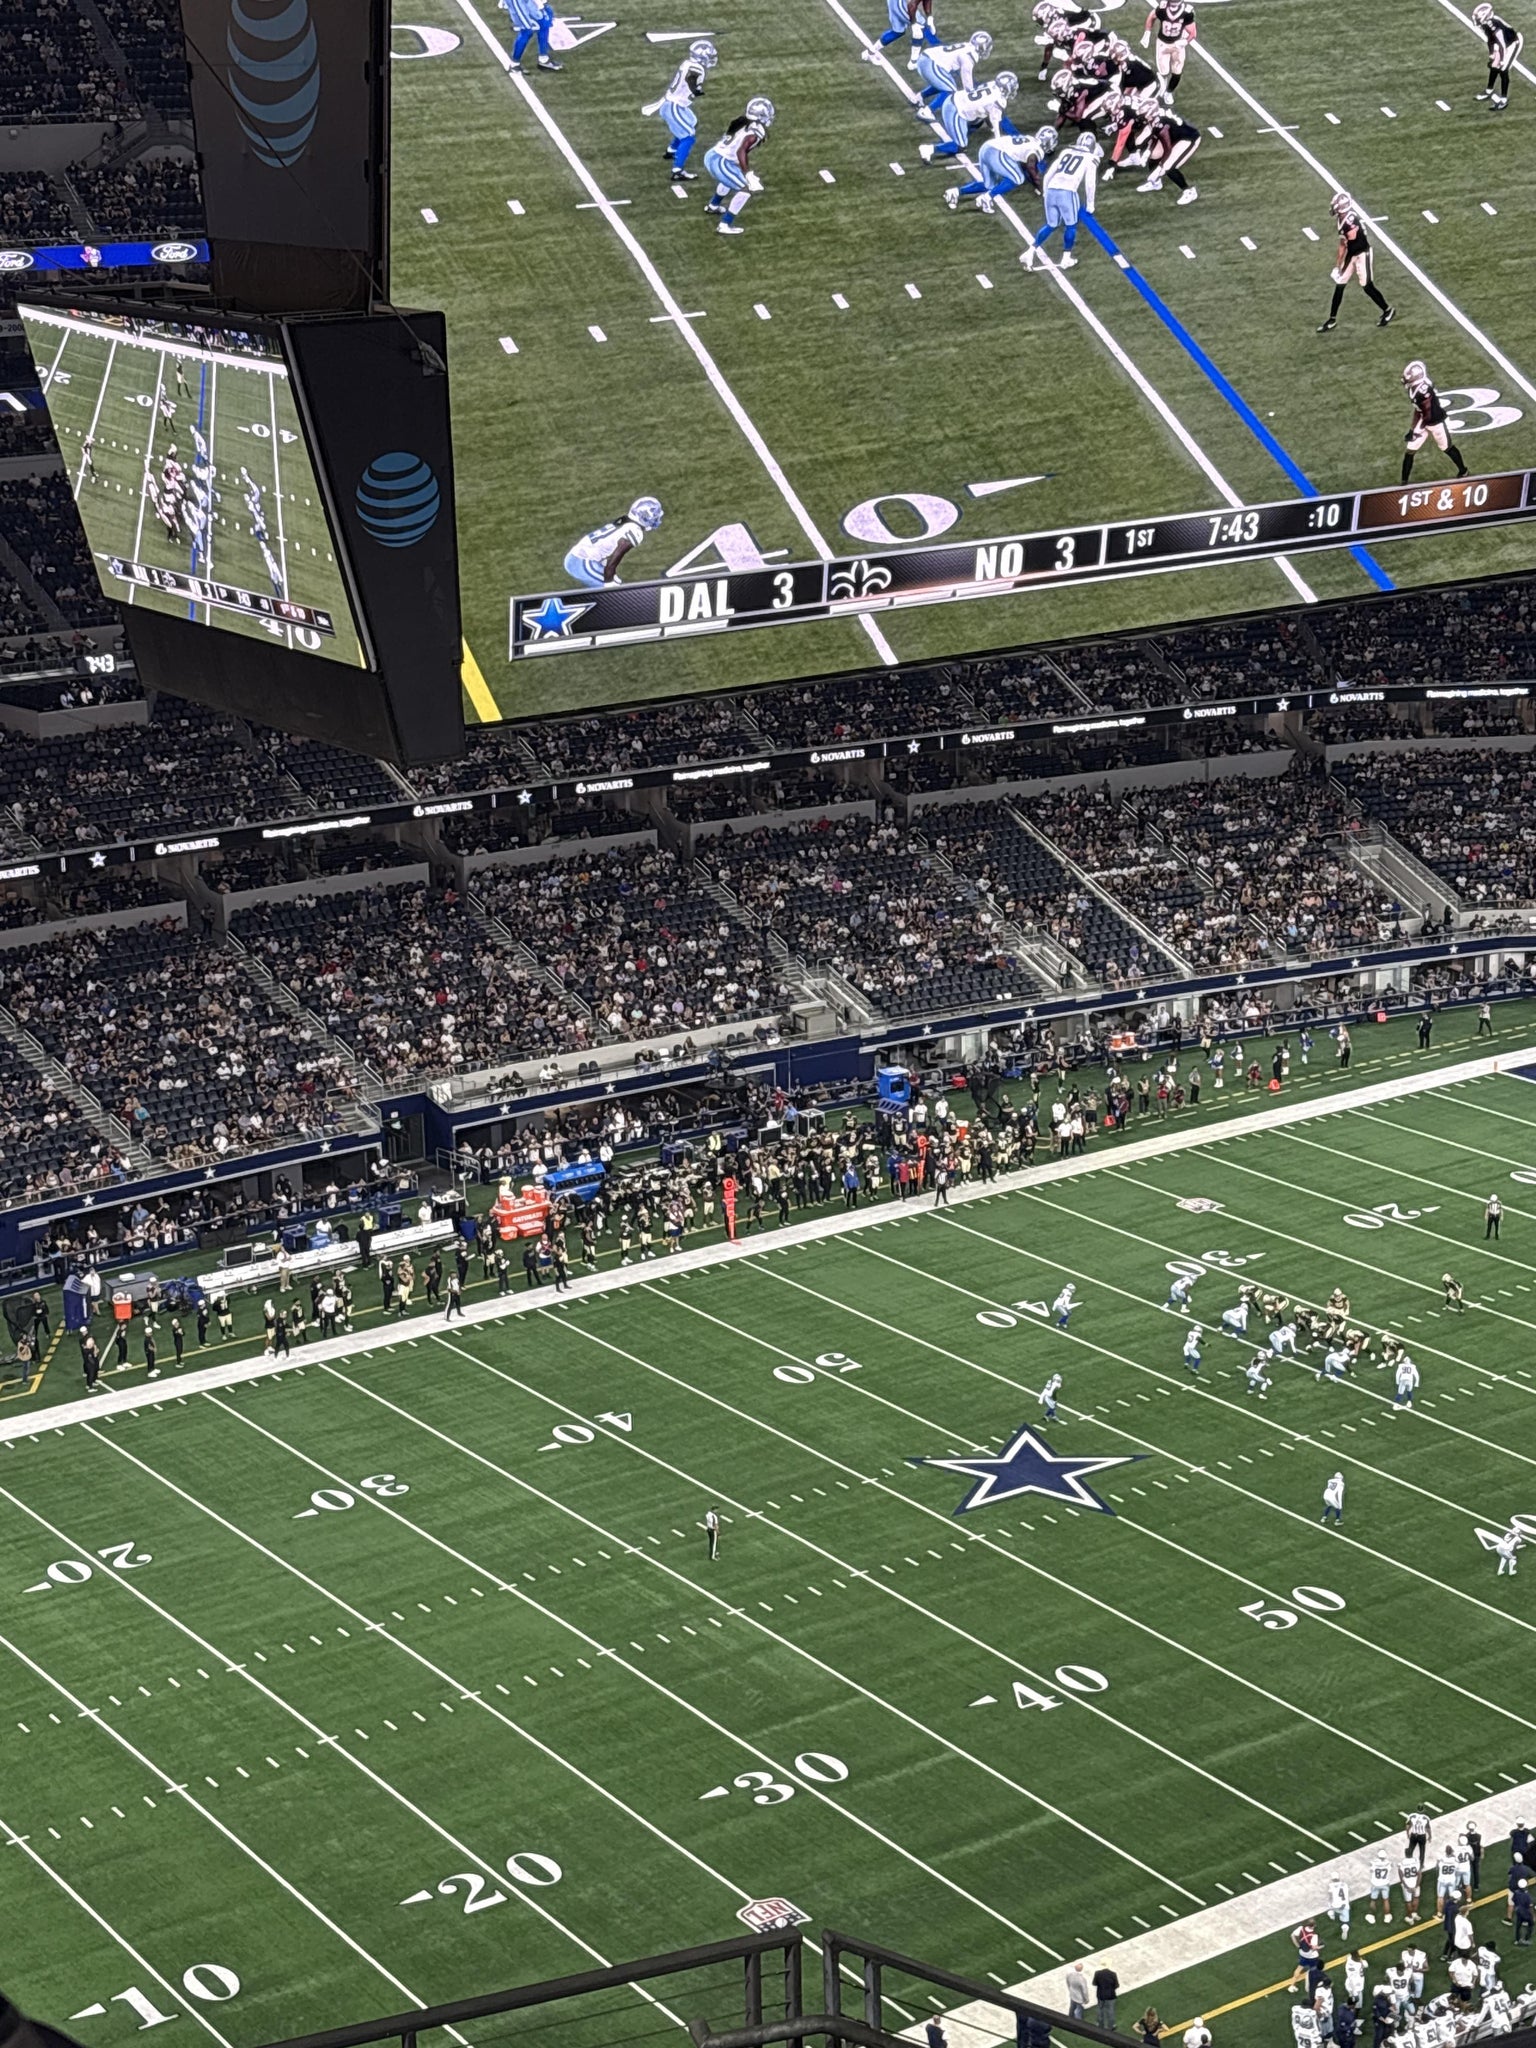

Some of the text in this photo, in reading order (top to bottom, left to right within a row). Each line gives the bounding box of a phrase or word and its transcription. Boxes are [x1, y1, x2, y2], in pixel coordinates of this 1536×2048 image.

[160, 245, 190, 260] Ford
[1399, 483, 1488, 517] 1ST & 10
[1125, 503, 1340, 555] 1ST 7:43 :10
[975, 536, 1076, 582] NO 3
[659, 572, 794, 624] DAL 3
[1339, 692, 1385, 703] NOVARTIS
[1193, 706, 1237, 719] NOVARTIS
[971, 730, 1015, 744] NOVARTIS
[821, 748, 866, 763] NOVARTIS
[586, 778, 634, 793] NOVARTIS
[424, 800, 473, 815] NOVARTIS
[1343, 1203, 1422, 1229] 20
[1165, 1251, 1247, 1277] 30
[976, 1300, 1051, 1328] 40
[773, 1352, 863, 1384] 50
[552, 1411, 632, 1444] 40
[310, 1474, 410, 1511] 30
[46, 1541, 153, 1584] 20
[1238, 1586, 1347, 1630] 50
[1012, 1665, 1109, 1712] 40
[733, 1752, 850, 1805] 30
[437, 1852, 563, 1914] 20
[1374, 1868, 1389, 1880] 87
[1404, 1866, 1418, 1878] 89
[1337, 1887, 1345, 1900] 4
[745, 1901, 791, 1922] NFL
[109, 1964, 241, 2031] 10
[1393, 1978, 1408, 1990] 68
